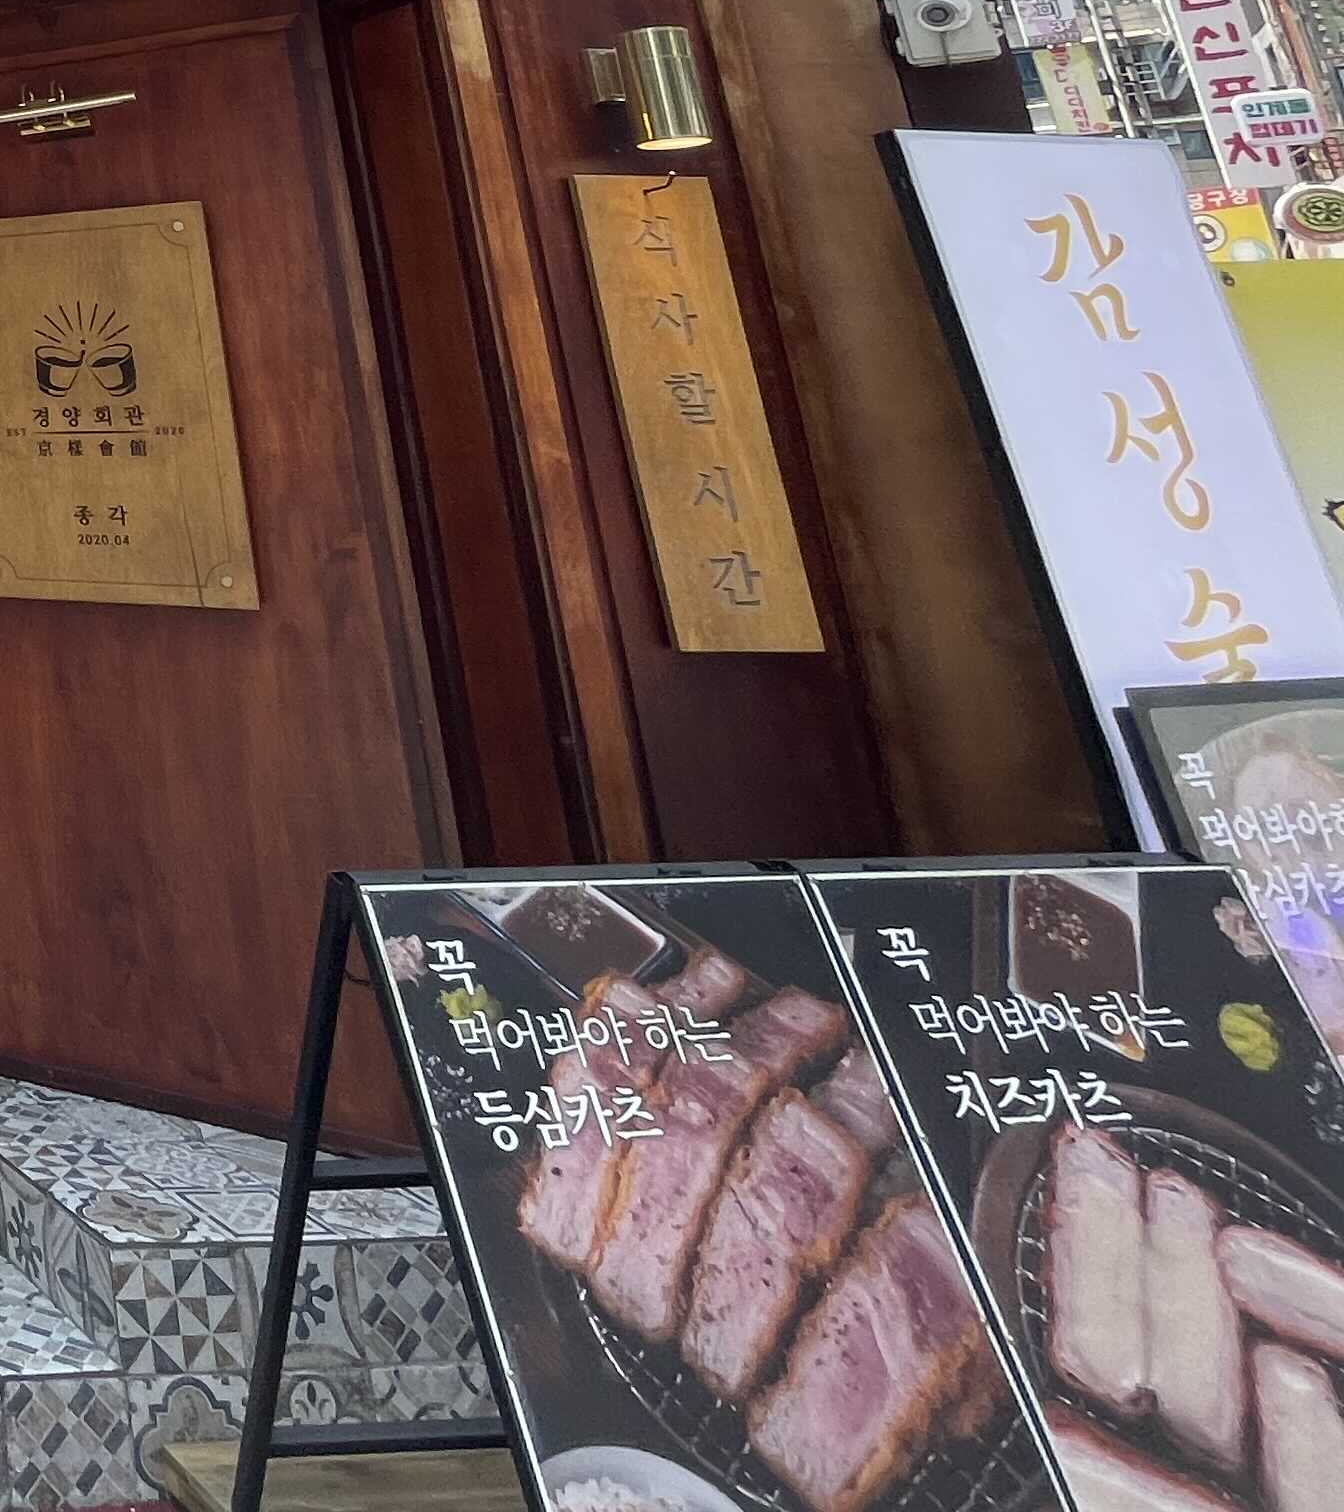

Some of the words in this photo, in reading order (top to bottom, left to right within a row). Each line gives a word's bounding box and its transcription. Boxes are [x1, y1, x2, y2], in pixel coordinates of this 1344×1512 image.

[32, 404, 146, 428] 경양회관
[73, 504, 129, 527] 종각
[77, 534, 131, 546] 2020.04
[1177, 752, 1216, 801] 꼭
[425, 938, 477, 995] 꼭
[876, 926, 931, 983] 꼭
[448, 1005, 634, 1072] 먹어봐야
[636, 1004, 734, 1065] 하는
[908, 991, 1091, 1056] 먹어봐야
[1088, 990, 1191, 1050] 하는
[473, 1084, 664, 1153] 등심카츠
[945, 1067, 1133, 1134] 치즈카츠
